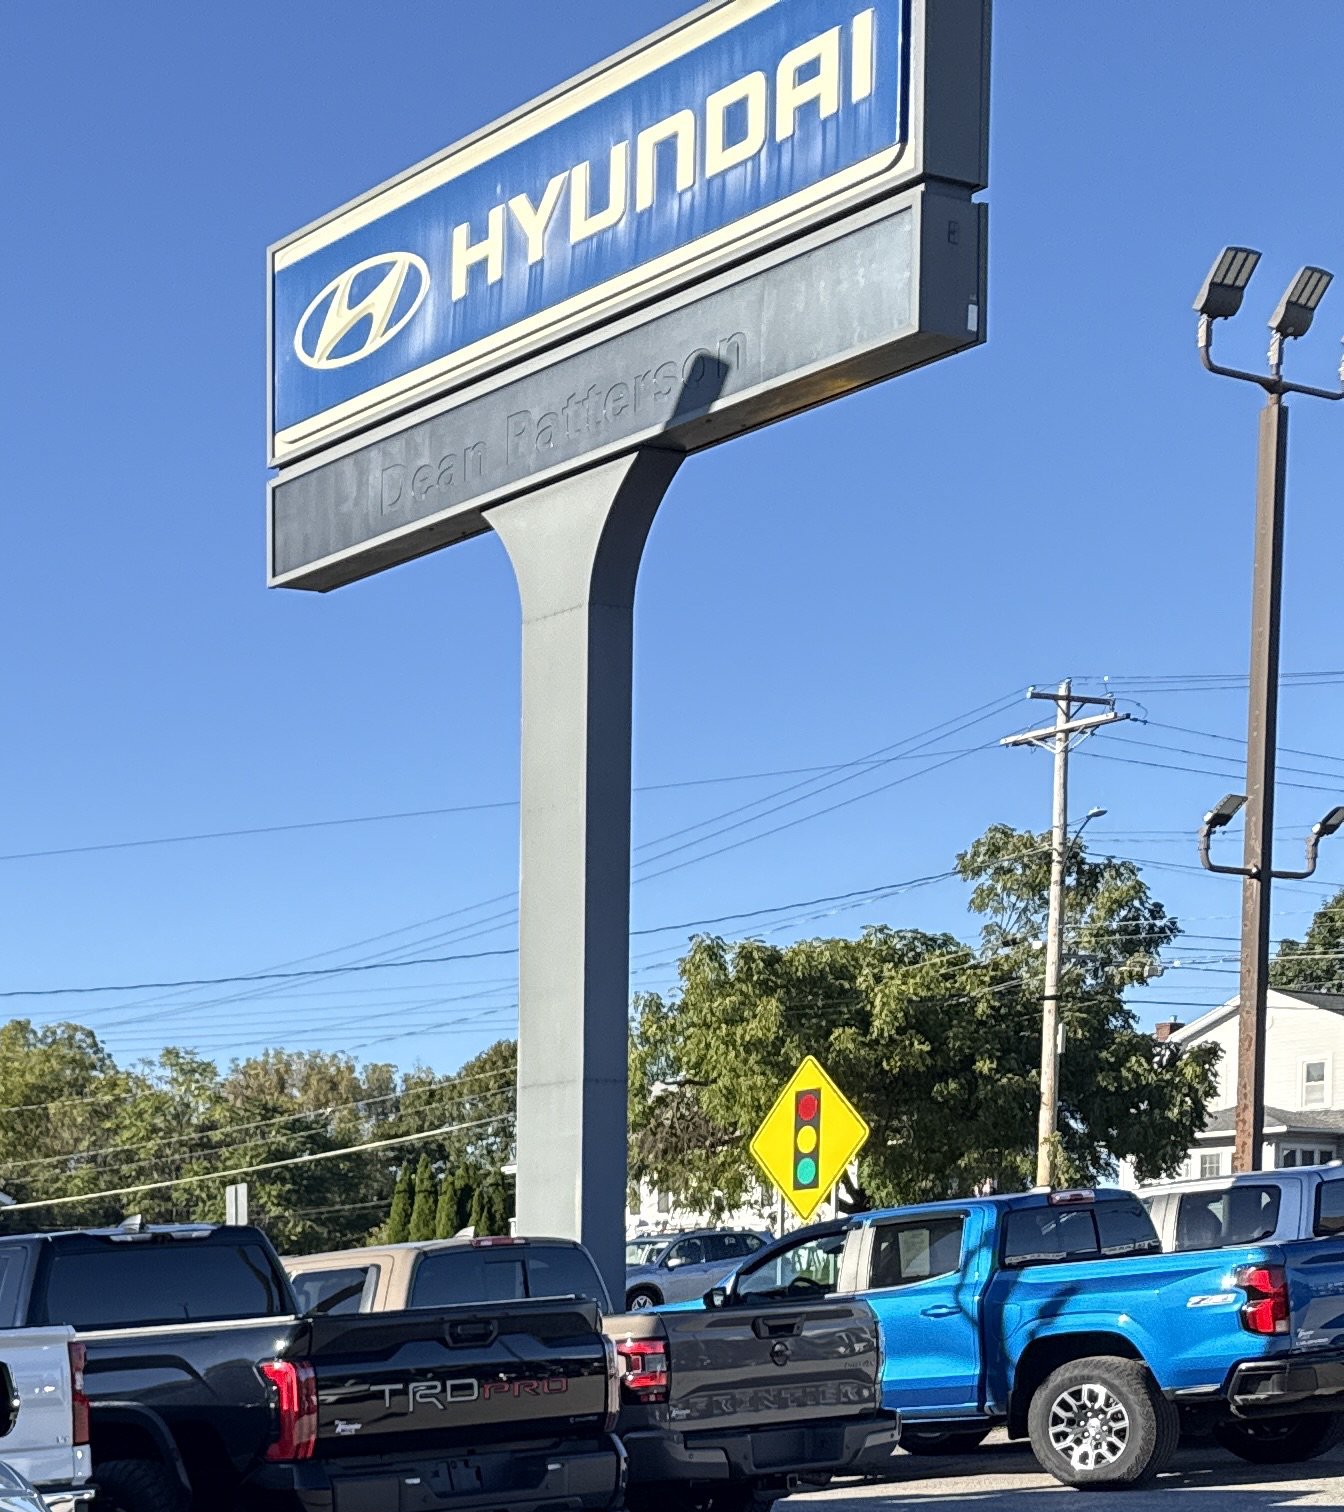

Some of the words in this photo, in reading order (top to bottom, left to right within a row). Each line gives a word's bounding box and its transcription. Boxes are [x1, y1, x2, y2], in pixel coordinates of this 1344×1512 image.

[451, 8, 875, 302] HYUNDAI
[381, 441, 487, 516] Dean
[505, 332, 748, 465] Patterson
[370, 1378, 480, 1412] TRD
[482, 1378, 568, 1399] PRO
